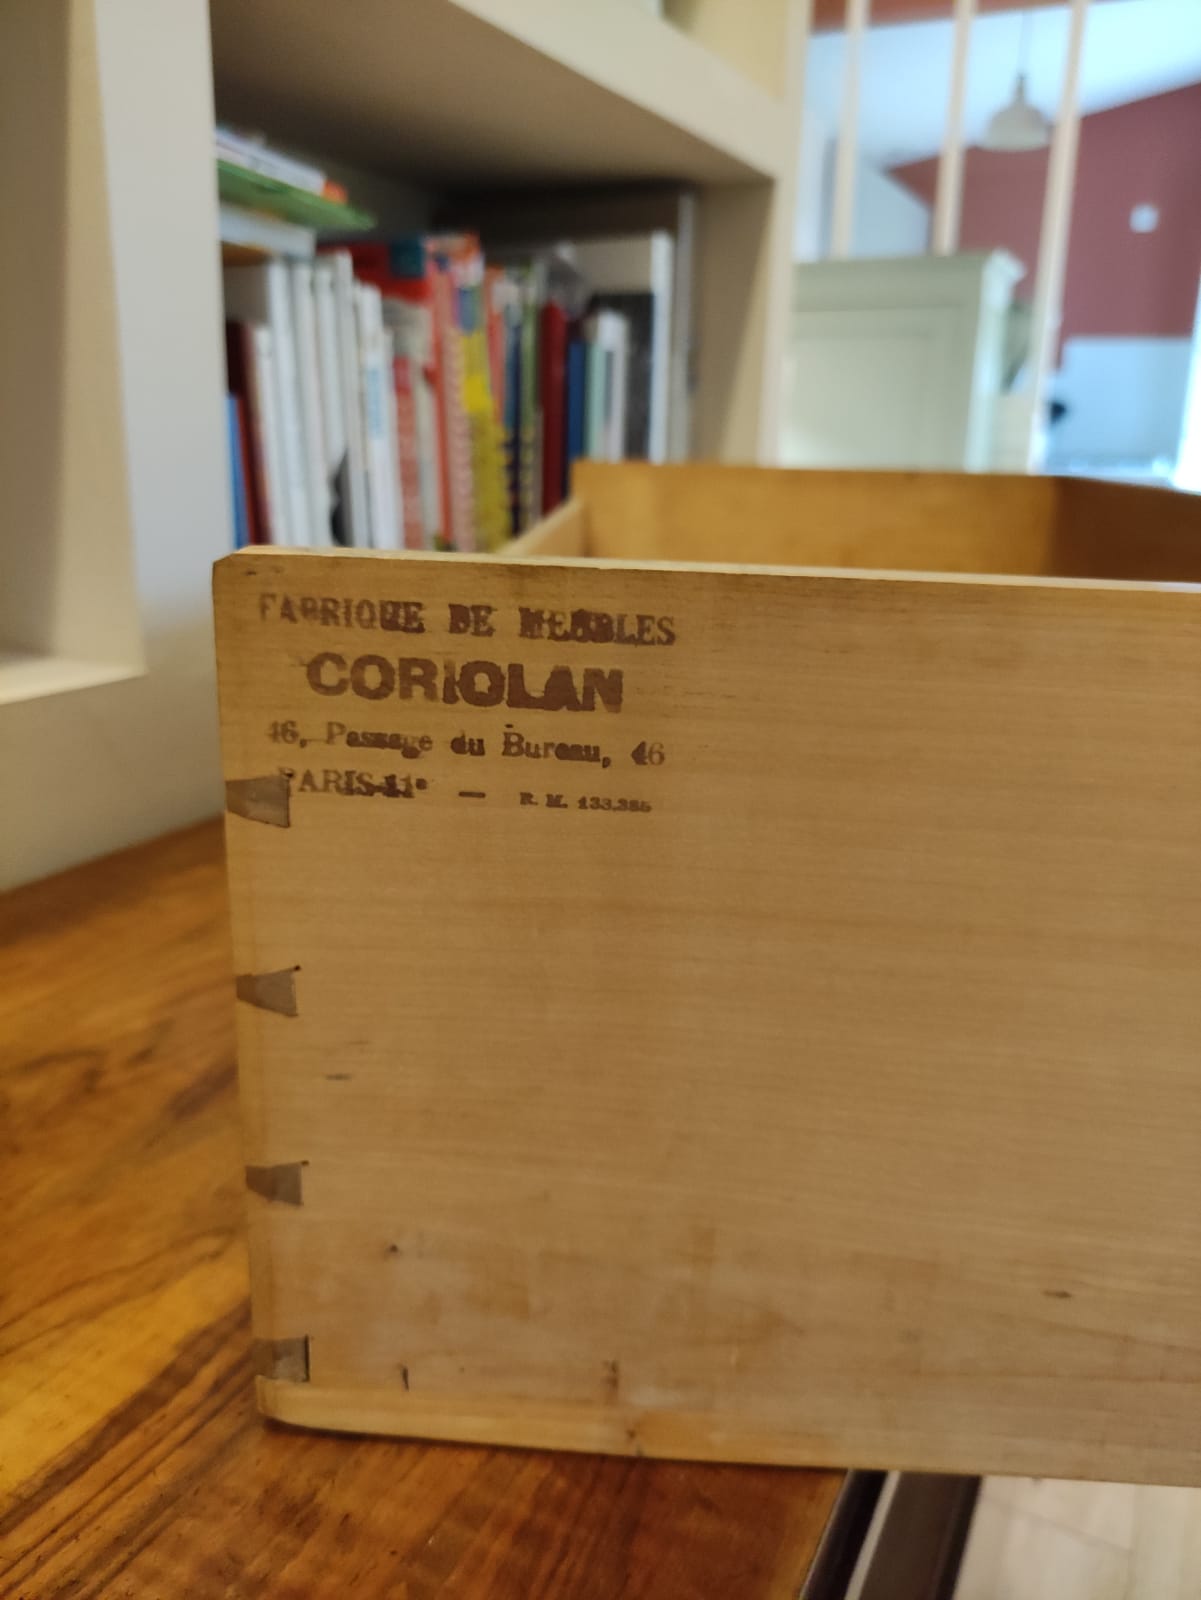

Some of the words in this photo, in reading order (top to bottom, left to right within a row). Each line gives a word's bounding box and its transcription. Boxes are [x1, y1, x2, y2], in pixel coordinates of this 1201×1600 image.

[258, 592, 425, 634] FABRIQUE
[448, 602, 494, 637] DE
[519, 606, 676, 646] MEUBLES
[305, 651, 624, 713] CORIOLAN
[326, 722, 433, 759] Passage
[450, 726, 486, 757] du
[502, 727, 611, 768] Bureau,
[631, 740, 666, 766] 46
